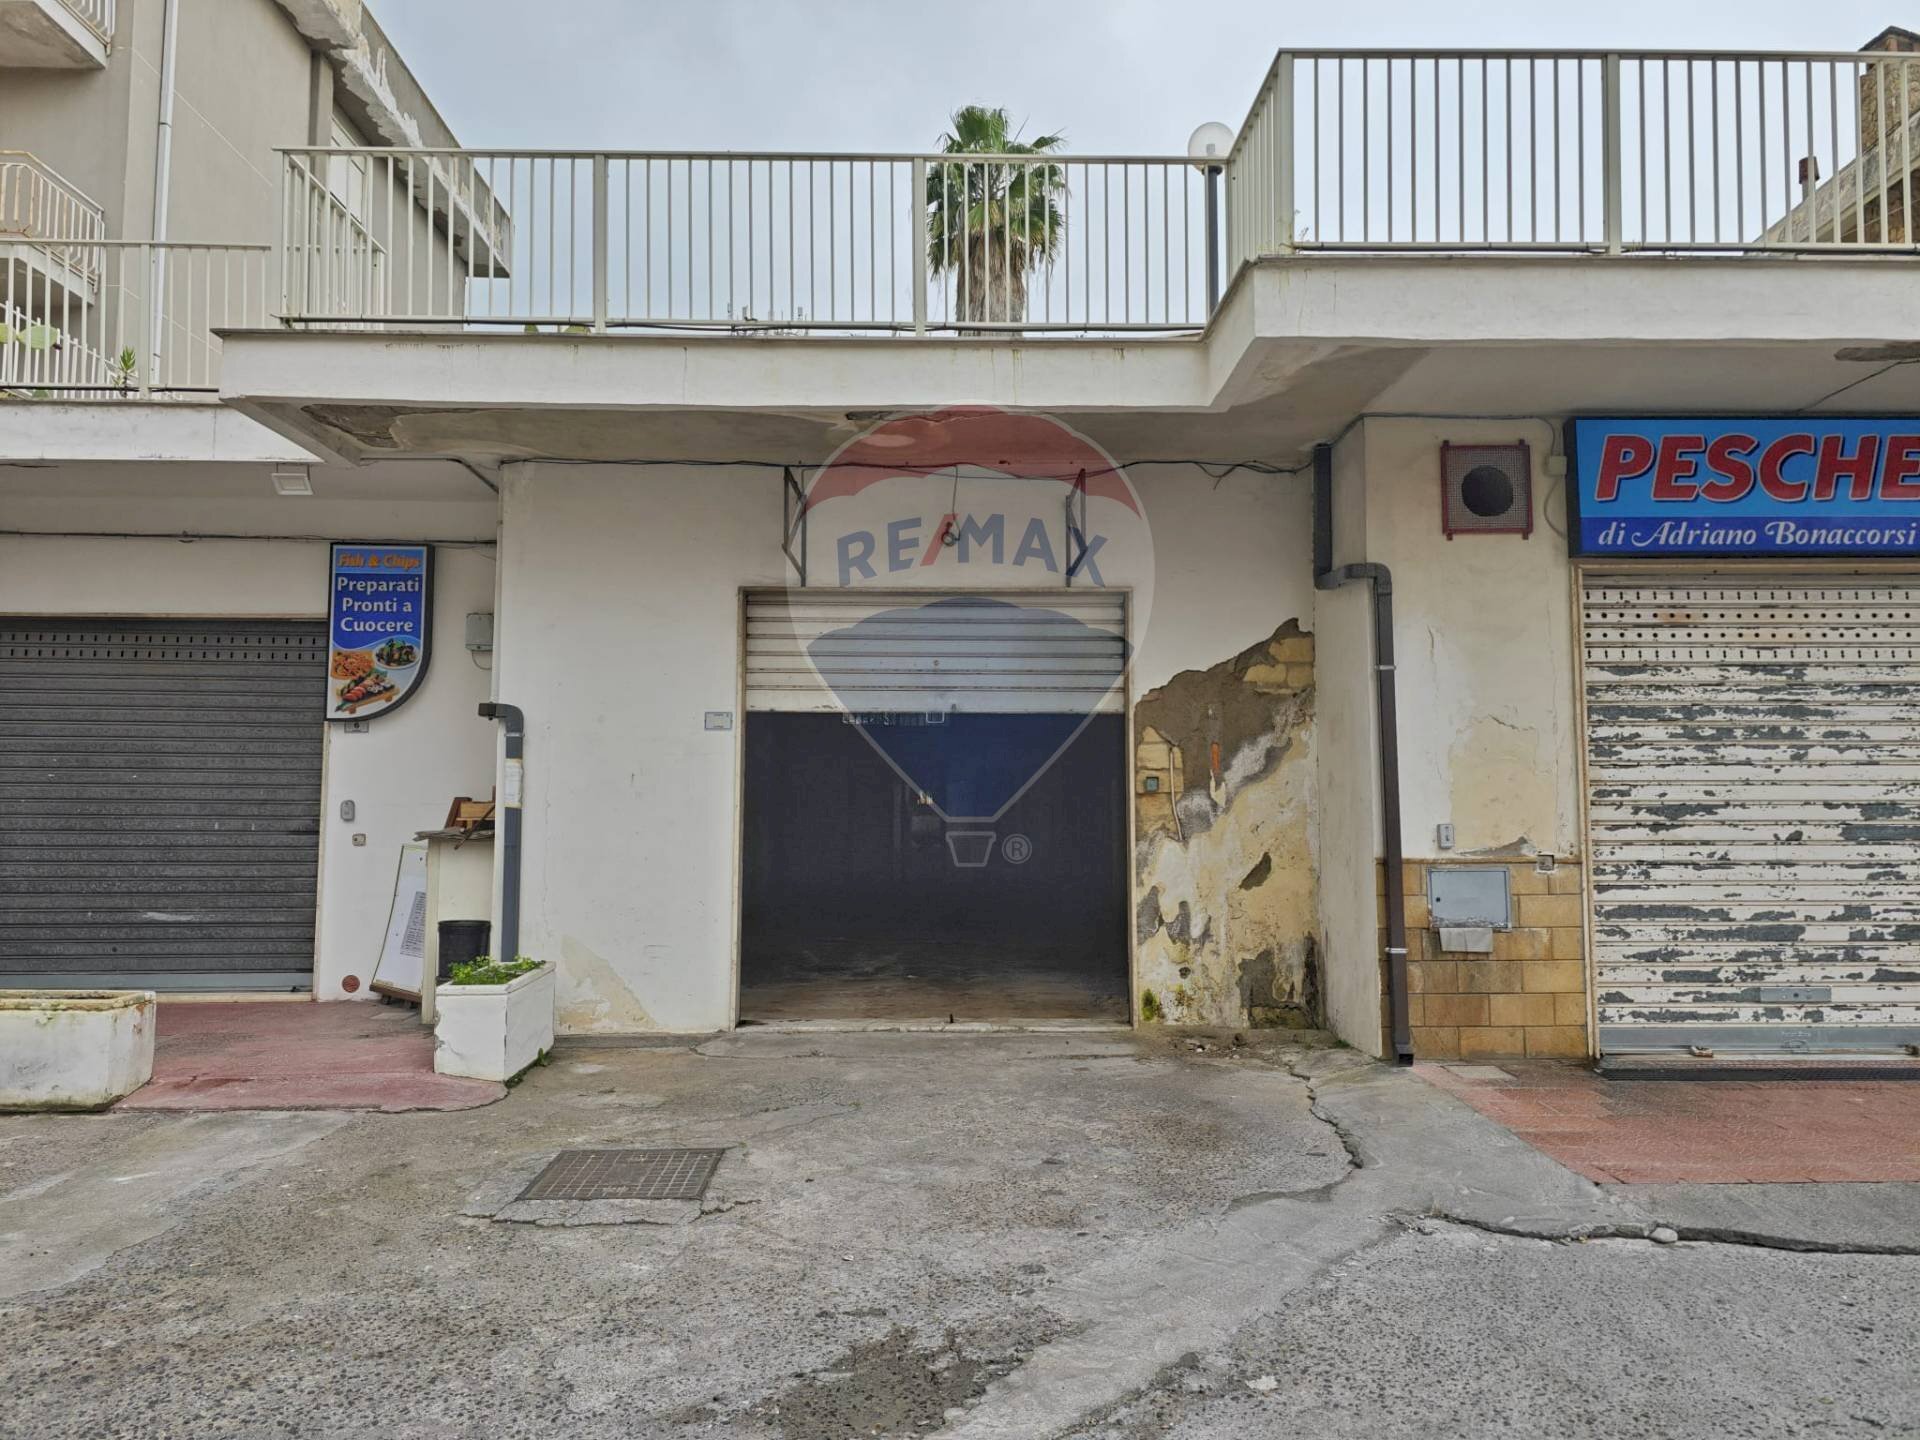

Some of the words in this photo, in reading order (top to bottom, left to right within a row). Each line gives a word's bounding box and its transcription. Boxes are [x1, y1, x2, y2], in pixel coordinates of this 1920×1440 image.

[1594, 433, 1920, 502] PESCHE
[1598, 521, 1626, 546] di
[1631, 520, 1757, 547] Adriano
[1764, 520, 1918, 546] Bonaccorsi
[338, 554, 364, 568] Fish
[367, 554, 380, 568] &
[383, 554, 420, 571] Chips
[337, 576, 420, 595] Preparati
[342, 597, 398, 612] Pronti
[402, 601, 413, 612] a
[340, 617, 414, 632] Cuocere
